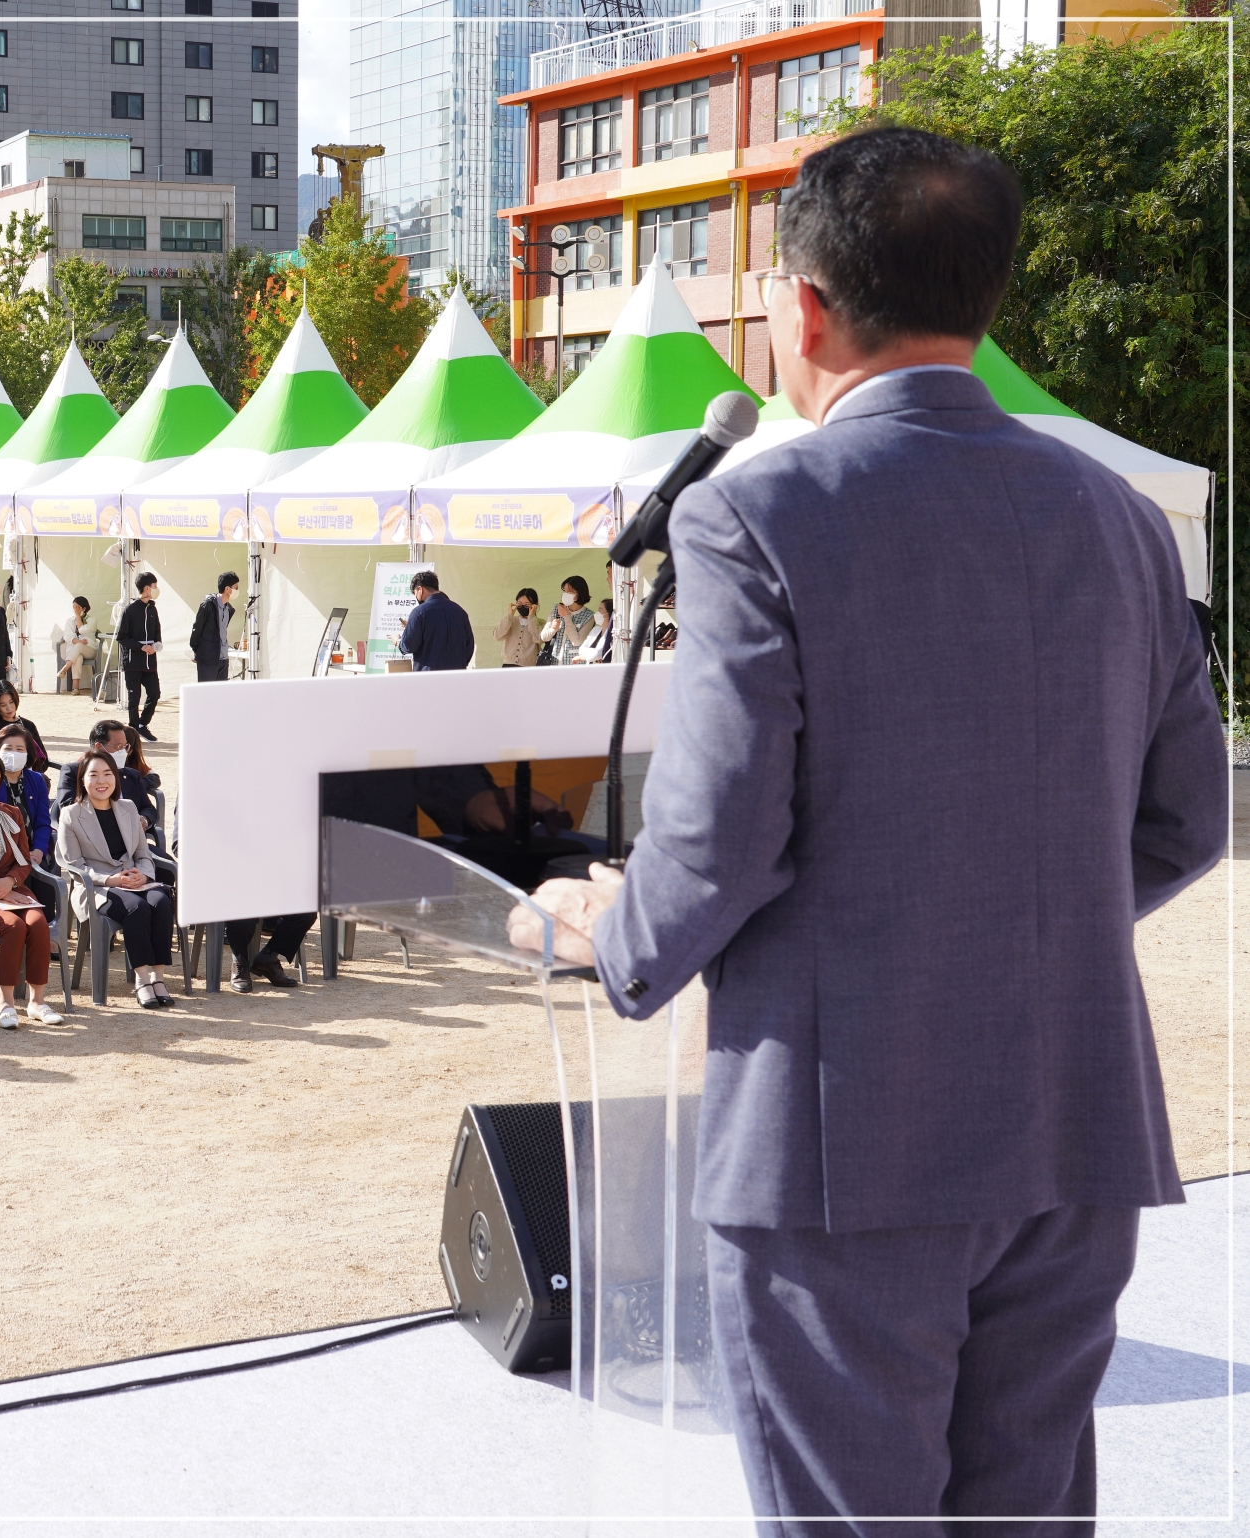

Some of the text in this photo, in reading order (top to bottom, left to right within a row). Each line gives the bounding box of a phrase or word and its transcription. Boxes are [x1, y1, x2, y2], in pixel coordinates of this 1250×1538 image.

[297, 515, 354, 530] 부산커피박물관
[474, 514, 543, 530] 스마트 역사투어
[383, 586, 402, 597] 역사
